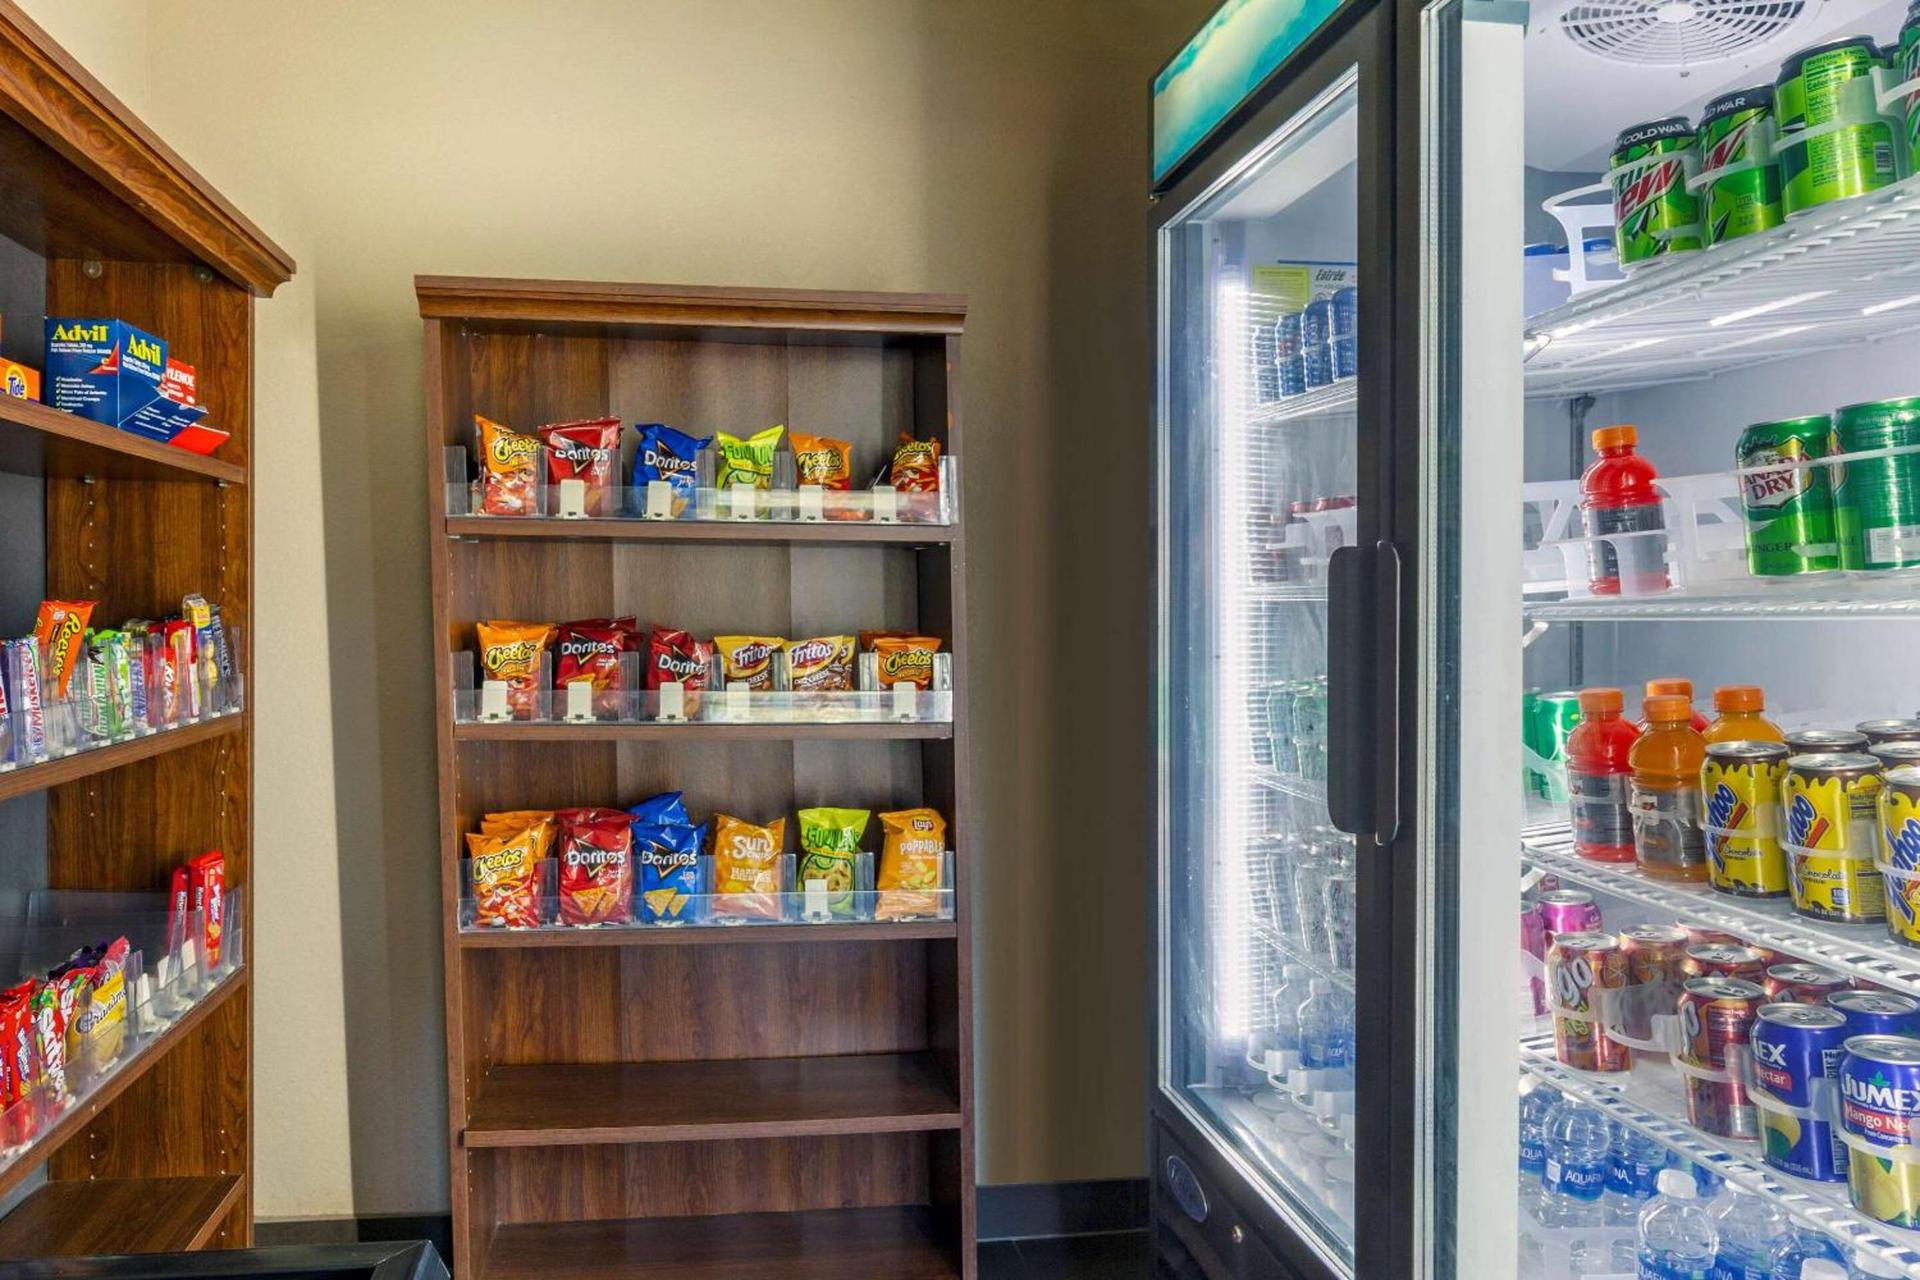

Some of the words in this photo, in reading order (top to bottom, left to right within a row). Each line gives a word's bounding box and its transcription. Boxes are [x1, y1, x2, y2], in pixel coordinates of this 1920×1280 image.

[1717, 97, 1746, 113] WAR
[1623, 129, 1657, 145] COLD
[1657, 123, 1685, 135] WAR
[51, 323, 109, 342] Advil
[127, 333, 161, 367] Advil
[8, 376, 26, 396] Tide
[165, 366, 194, 388] YLENOL
[555, 446, 609, 462] Doritos
[644, 449, 697, 471] Doritos
[797, 449, 842, 475] Cheetos
[1752, 473, 1795, 501] DRY
[53, 612, 82, 677] Reese's
[561, 641, 616, 657] Doritos
[732, 644, 772, 667] Fritos
[791, 641, 834, 667] Fritos
[486, 641, 537, 673] Cheetos
[658, 653, 708, 676] Doritos
[885, 649, 933, 675] Cheetos
[913, 819, 933, 831] Lay's
[473, 849, 524, 884] Cheetos
[566, 849, 626, 866] Doritos
[641, 849, 697, 866] Doritos
[1759, 1069, 1786, 1085] ectar
